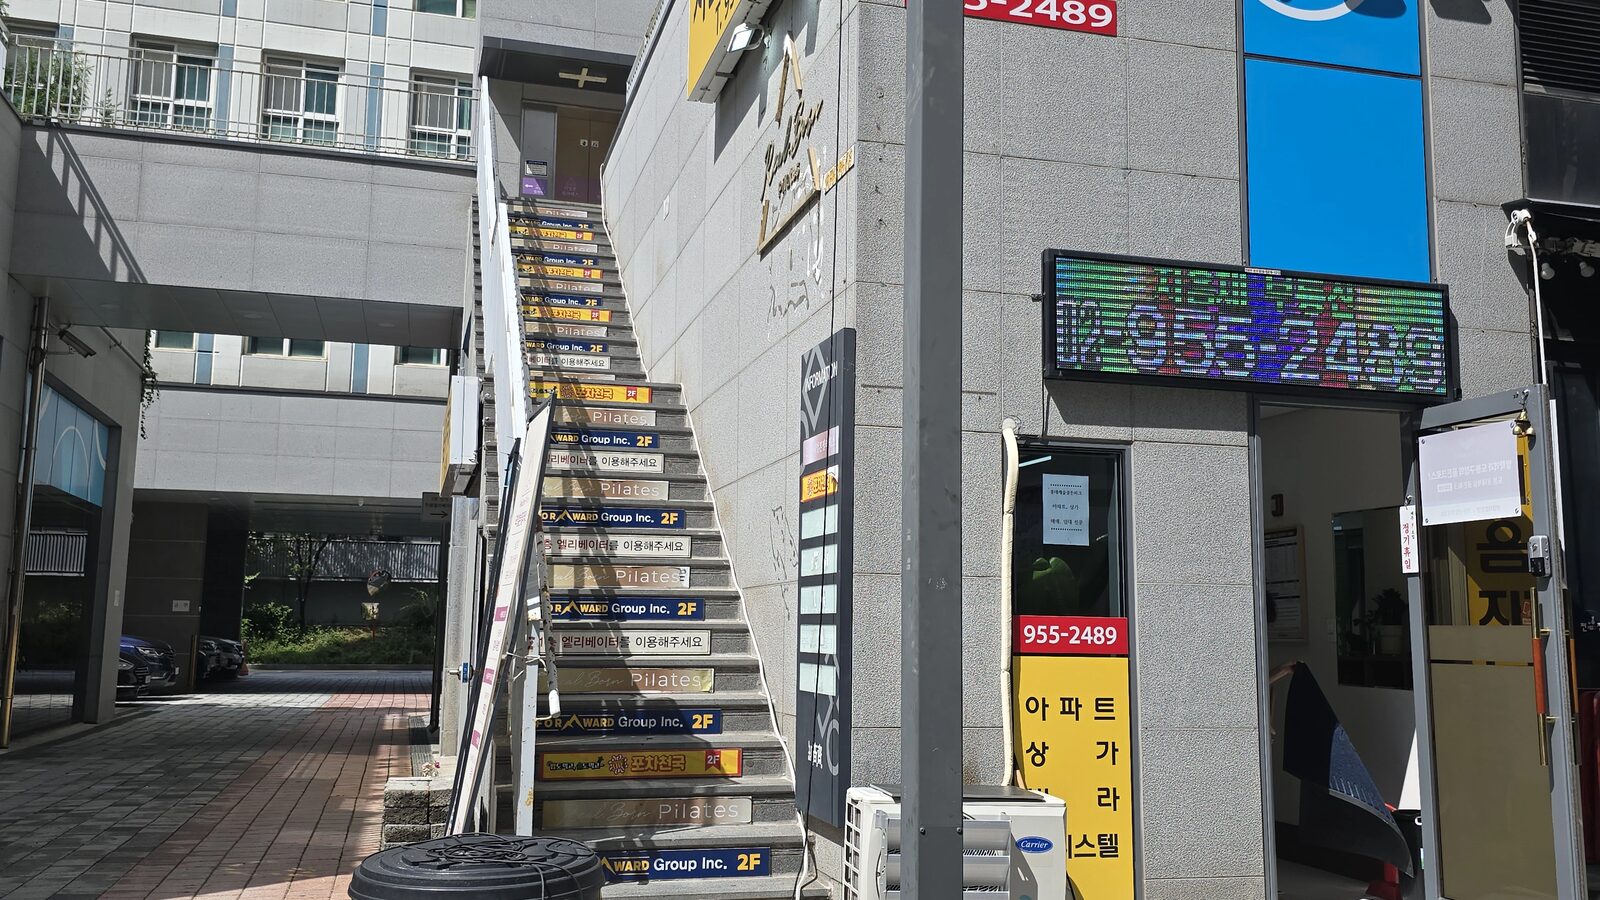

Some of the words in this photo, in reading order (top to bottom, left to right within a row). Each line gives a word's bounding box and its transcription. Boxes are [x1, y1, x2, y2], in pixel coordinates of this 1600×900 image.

[543, 256, 565, 264] Group
[544, 297, 567, 306] Group
[568, 298, 581, 306] Inc.
[556, 326, 602, 336] Pilates
[546, 342, 570, 351] Group
[571, 343, 586, 352] Inc.
[590, 344, 603, 353] 2F
[561, 358, 605, 368] 이용해주세요
[576, 386, 614, 400] 포차천국
[593, 411, 647, 425] Pilates
[555, 433, 579, 442] WARD
[581, 434, 611, 446] Group
[613, 436, 631, 445] Inc.
[636, 435, 653, 447] 2F
[601, 456, 658, 467] 이용해주세요
[600, 483, 660, 497] Pilates
[572, 512, 599, 521] WARD
[601, 512, 633, 524] Group
[636, 513, 655, 523] Inc.
[660, 512, 679, 525] 2F
[557, 539, 619, 551] 엘리베이터를
[623, 540, 684, 552] 이용해주세요
[1402, 522, 1412, 570] 정기휴일
[616, 570, 680, 584] Pilates
[579, 604, 608, 613] WARD
[611, 603, 646, 616] Group
[650, 603, 670, 614] Inc.
[677, 602, 697, 616] 2F
[1023, 624, 1117, 645] 955-2489
[561, 636, 630, 648] 엘리베이터를
[635, 637, 703, 648] 이용해주세요
[630, 673, 701, 687] Pilates
[583, 717, 615, 728] WARD
[618, 716, 657, 729] Group
[661, 715, 684, 728] Inc.
[691, 714, 713, 729] 2F
[630, 754, 686, 772] 포차천국
[707, 755, 720, 765] 2F
[659, 803, 739, 820] Pilates
[1020, 839, 1049, 850] Carrier
[614, 860, 650, 872] WARD
[653, 857, 697, 871] Group
[702, 855, 728, 870] Inc.
[737, 853, 761, 871] 2F
